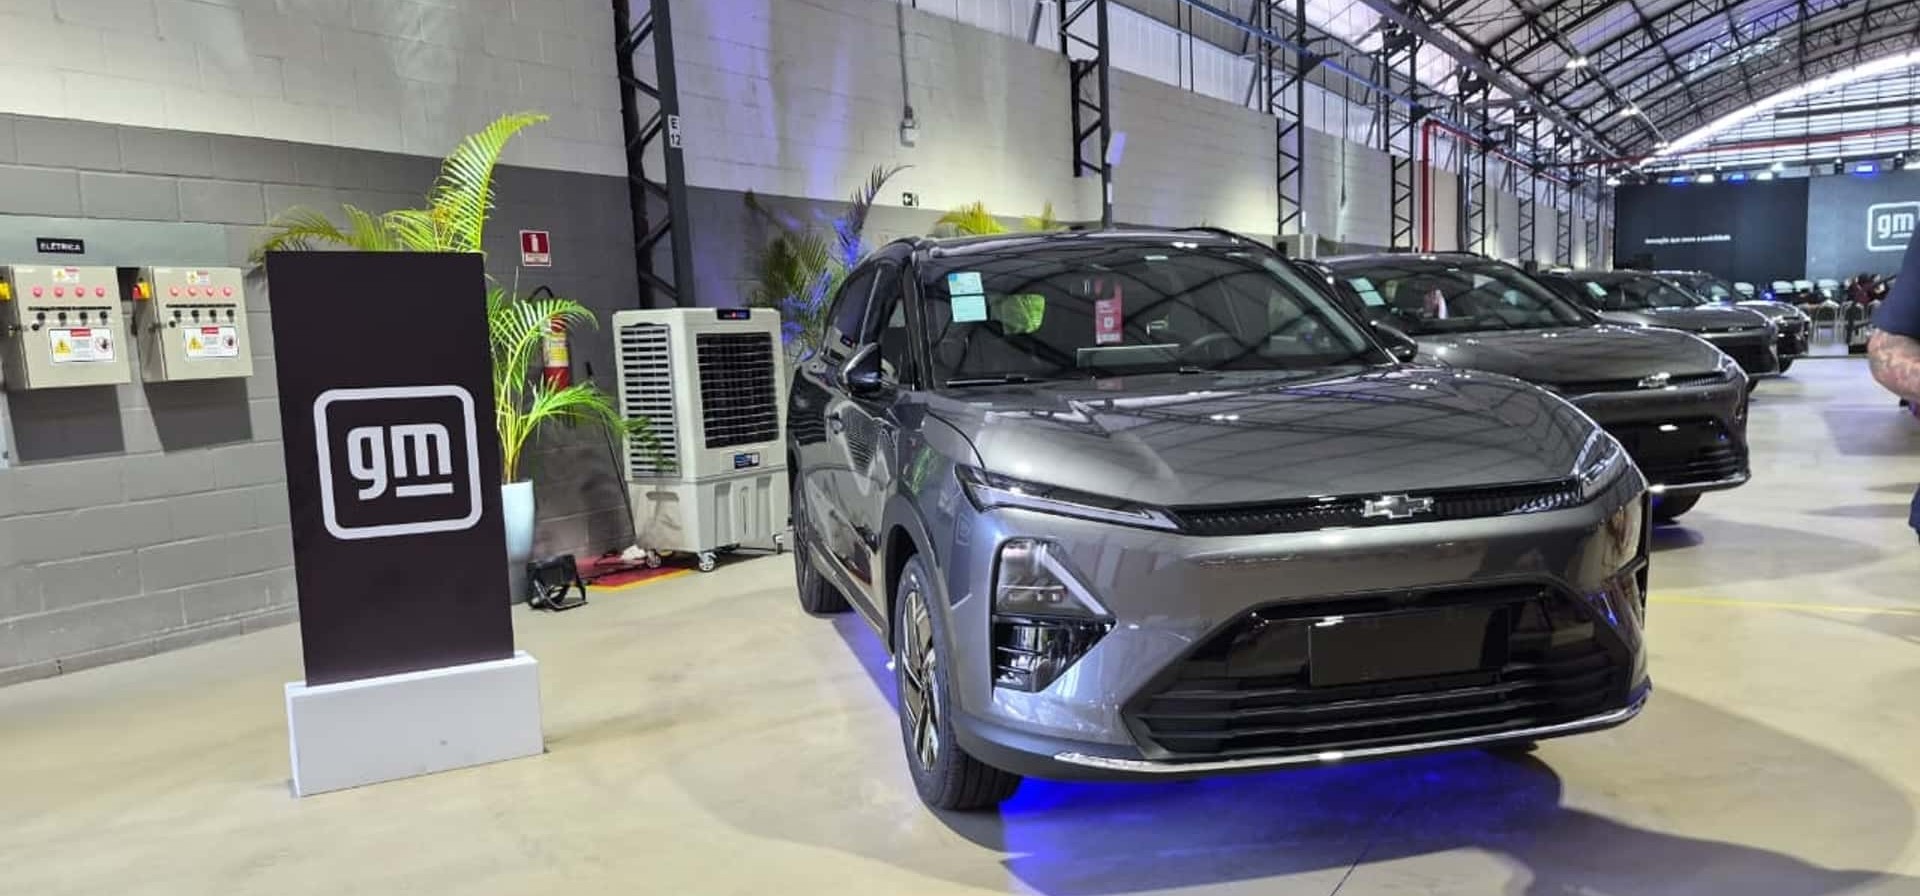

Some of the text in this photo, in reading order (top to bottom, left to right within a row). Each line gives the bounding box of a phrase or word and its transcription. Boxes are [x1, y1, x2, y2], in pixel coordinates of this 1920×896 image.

[672, 118, 678, 129] E
[671, 134, 680, 146] 12
[1877, 213, 1914, 239] gm
[347, 423, 454, 500] gm
